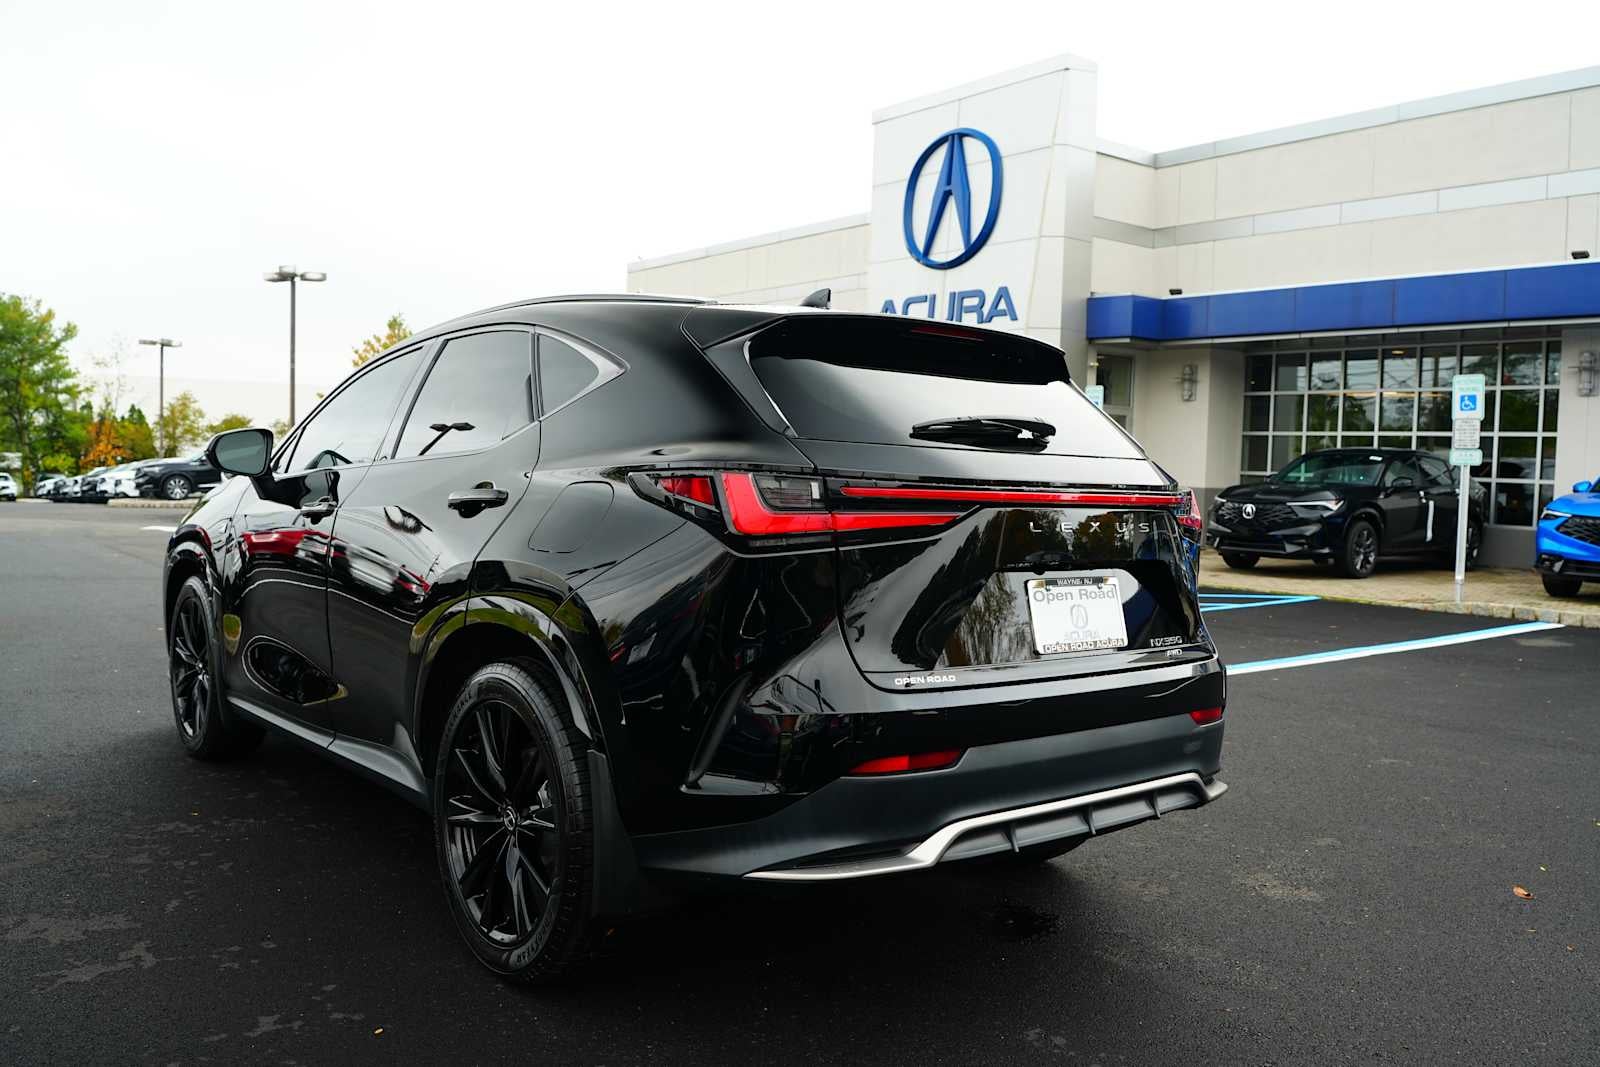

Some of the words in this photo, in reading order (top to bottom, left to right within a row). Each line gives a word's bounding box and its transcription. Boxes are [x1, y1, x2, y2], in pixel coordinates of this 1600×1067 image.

[1029, 521, 1150, 533] LEXUS
[1033, 590, 1074, 604] Open
[1079, 587, 1116, 600] Road
[1044, 642, 1069, 653] OPEN
[1070, 640, 1094, 651] ROAD
[1096, 638, 1124, 649] ACURA
[894, 676, 925, 686] OPEN
[926, 675, 956, 684] ROAD
